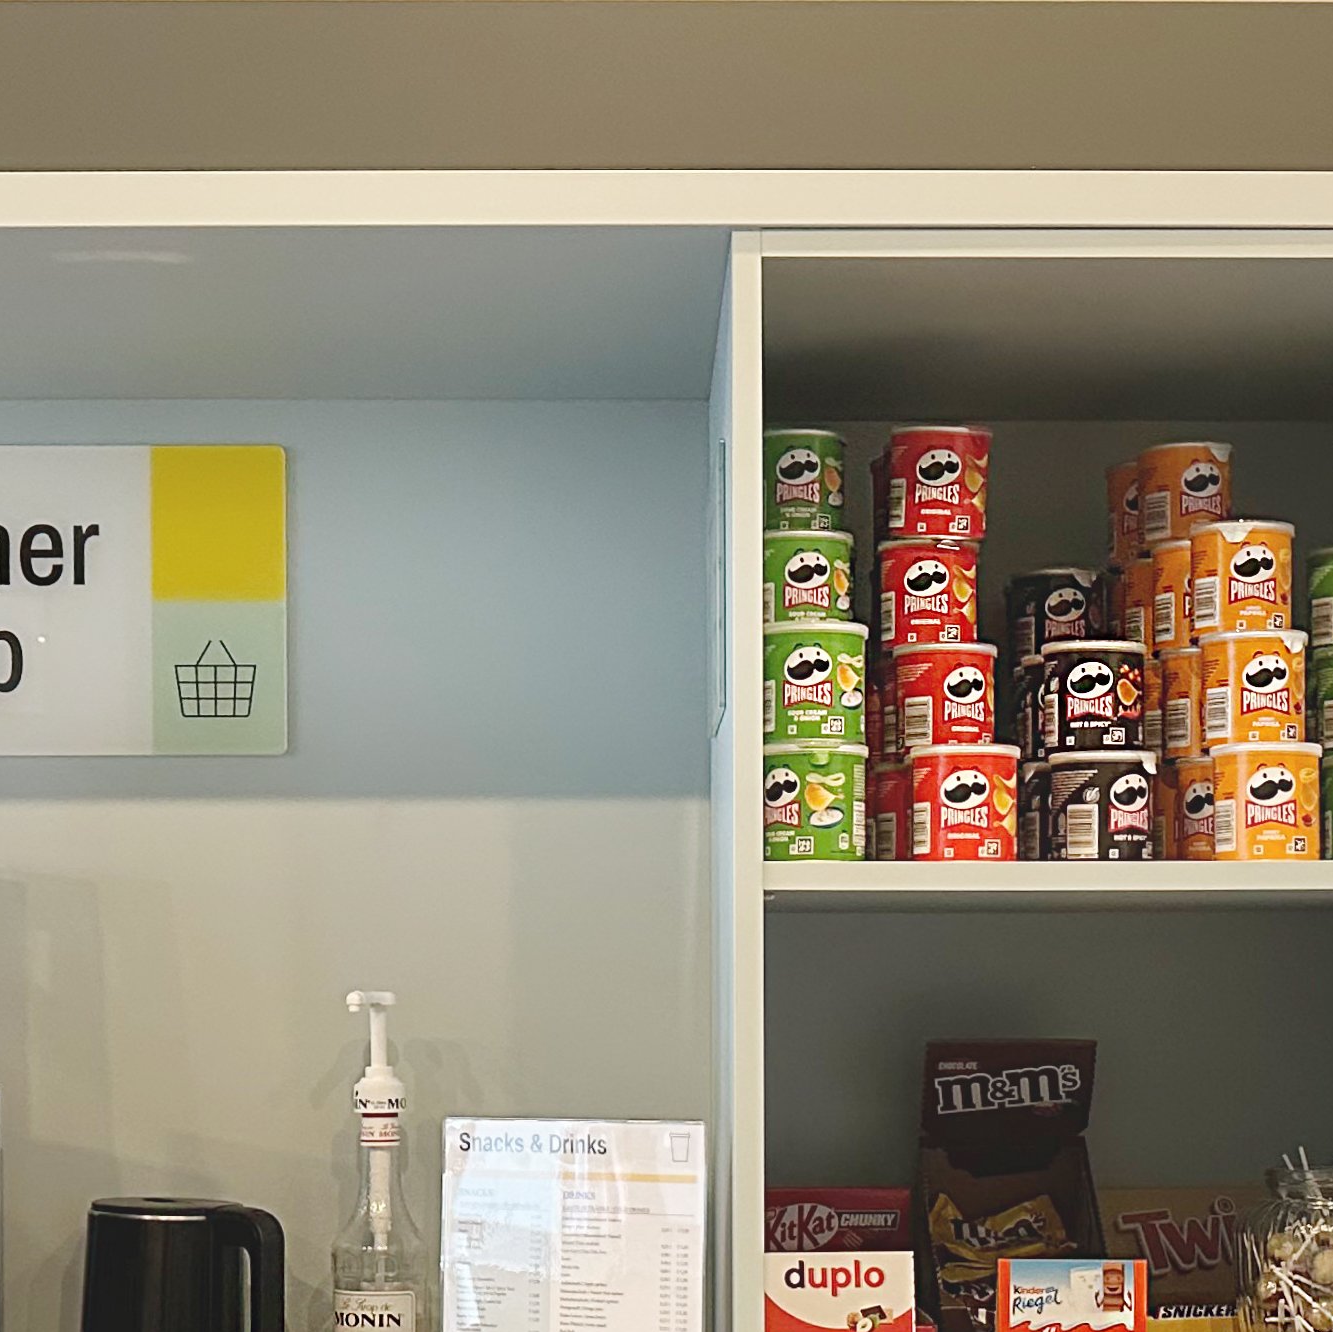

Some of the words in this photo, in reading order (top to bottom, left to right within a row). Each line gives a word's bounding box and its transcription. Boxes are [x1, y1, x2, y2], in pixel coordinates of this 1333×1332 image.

[776, 483, 820, 504] PRINGLES
[915, 483, 960, 505] PRINGLES
[1181, 494, 1222, 515] PRINGLES
[785, 586, 829, 607] PRINGLES
[1230, 578, 1276, 604] PRINGLES
[904, 595, 948, 615] PRINGLES
[1045, 620, 1086, 639] PRINGLES
[785, 683, 832, 706] PRINGLES
[1242, 690, 1289, 714] PRINGLES
[944, 701, 985, 722] PRINGLES
[1068, 695, 1112, 718] PRINGLES
[941, 806, 988, 829] PRINGLES
[1110, 808, 1148, 831] PRINGLES
[1246, 802, 1296, 826] PRINGLES
[459, 1132, 525, 1153] Snacks
[531, 1135, 543, 1154] &
[549, 1134, 607, 1155] Drinks
[840, 1211, 897, 1228] CHUNKY
[1121, 1196, 1236, 1278] Twi
[784, 1260, 885, 1297] duplo
[1012, 1290, 1063, 1315] Riegel
[1162, 1304, 1237, 1319] SNICKER
[335, 1311, 401, 1328] MONIN
